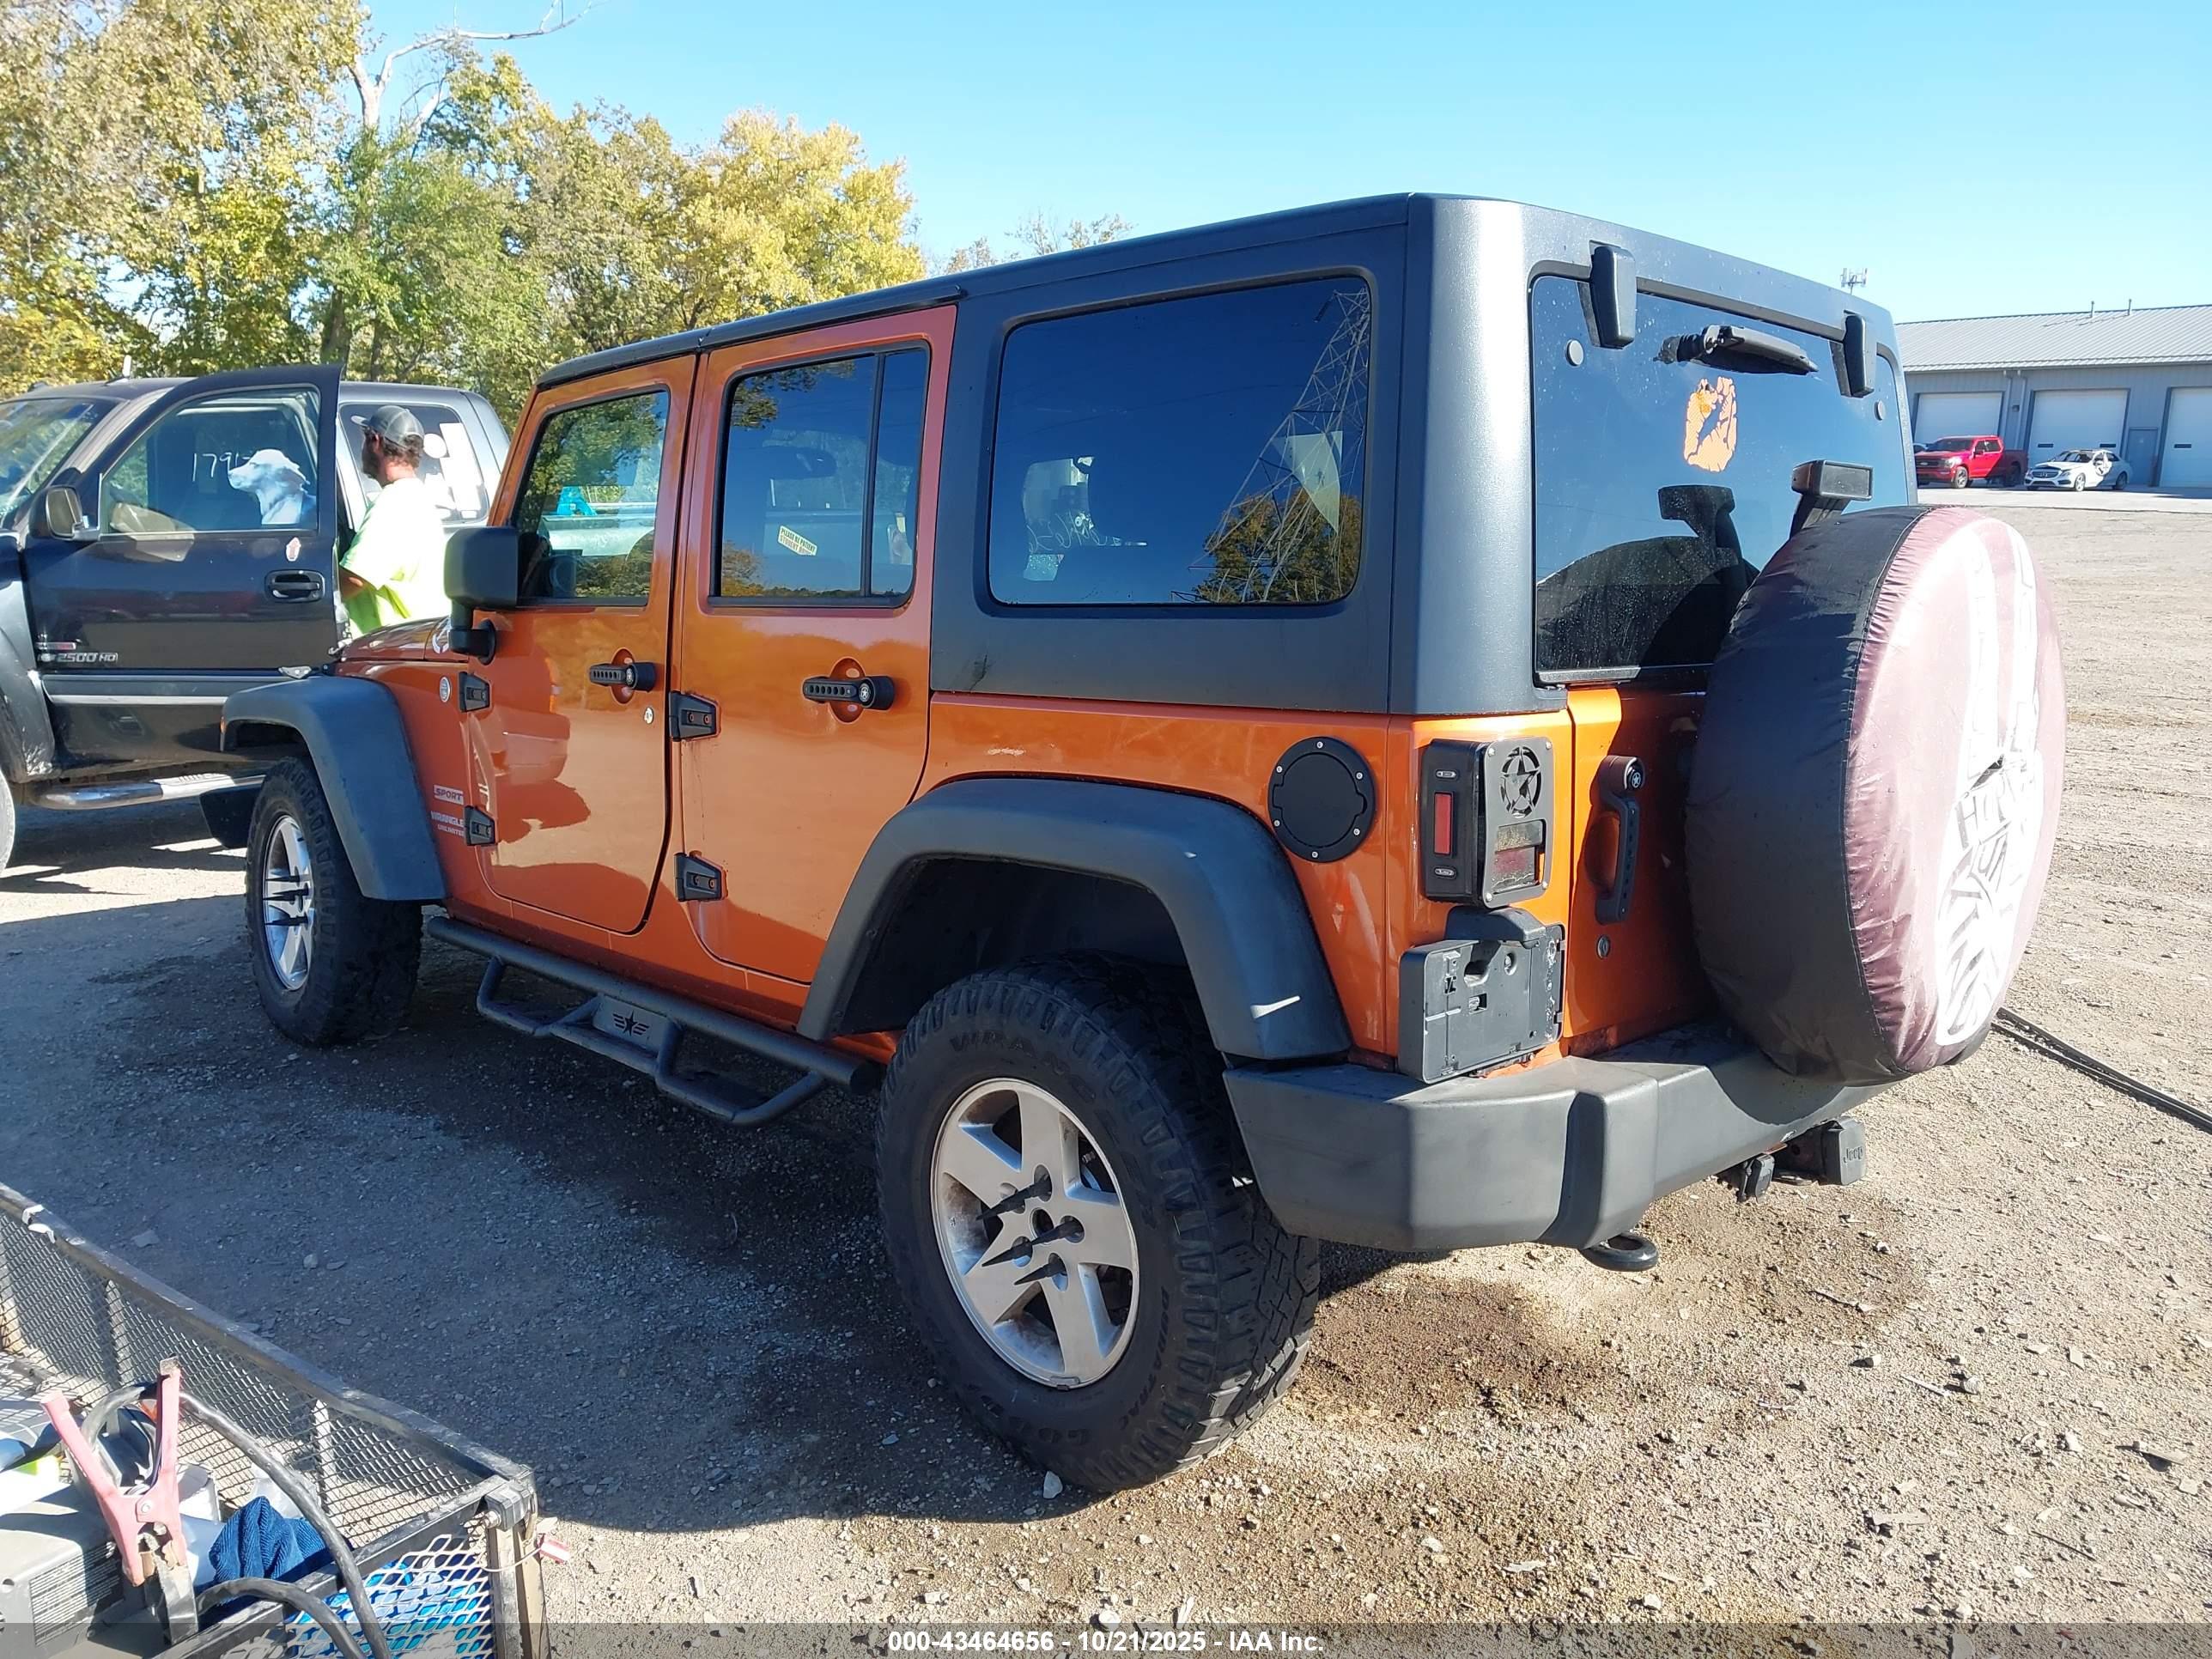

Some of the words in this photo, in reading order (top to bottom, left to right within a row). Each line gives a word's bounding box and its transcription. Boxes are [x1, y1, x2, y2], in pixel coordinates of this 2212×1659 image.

[799, 538, 816, 552] PATIENT
[57, 653, 98, 663] 2500
[435, 788, 462, 800] SPORT
[431, 811, 465, 827] WRANGLE
[1843, 1146, 1863, 1164] Jeep
